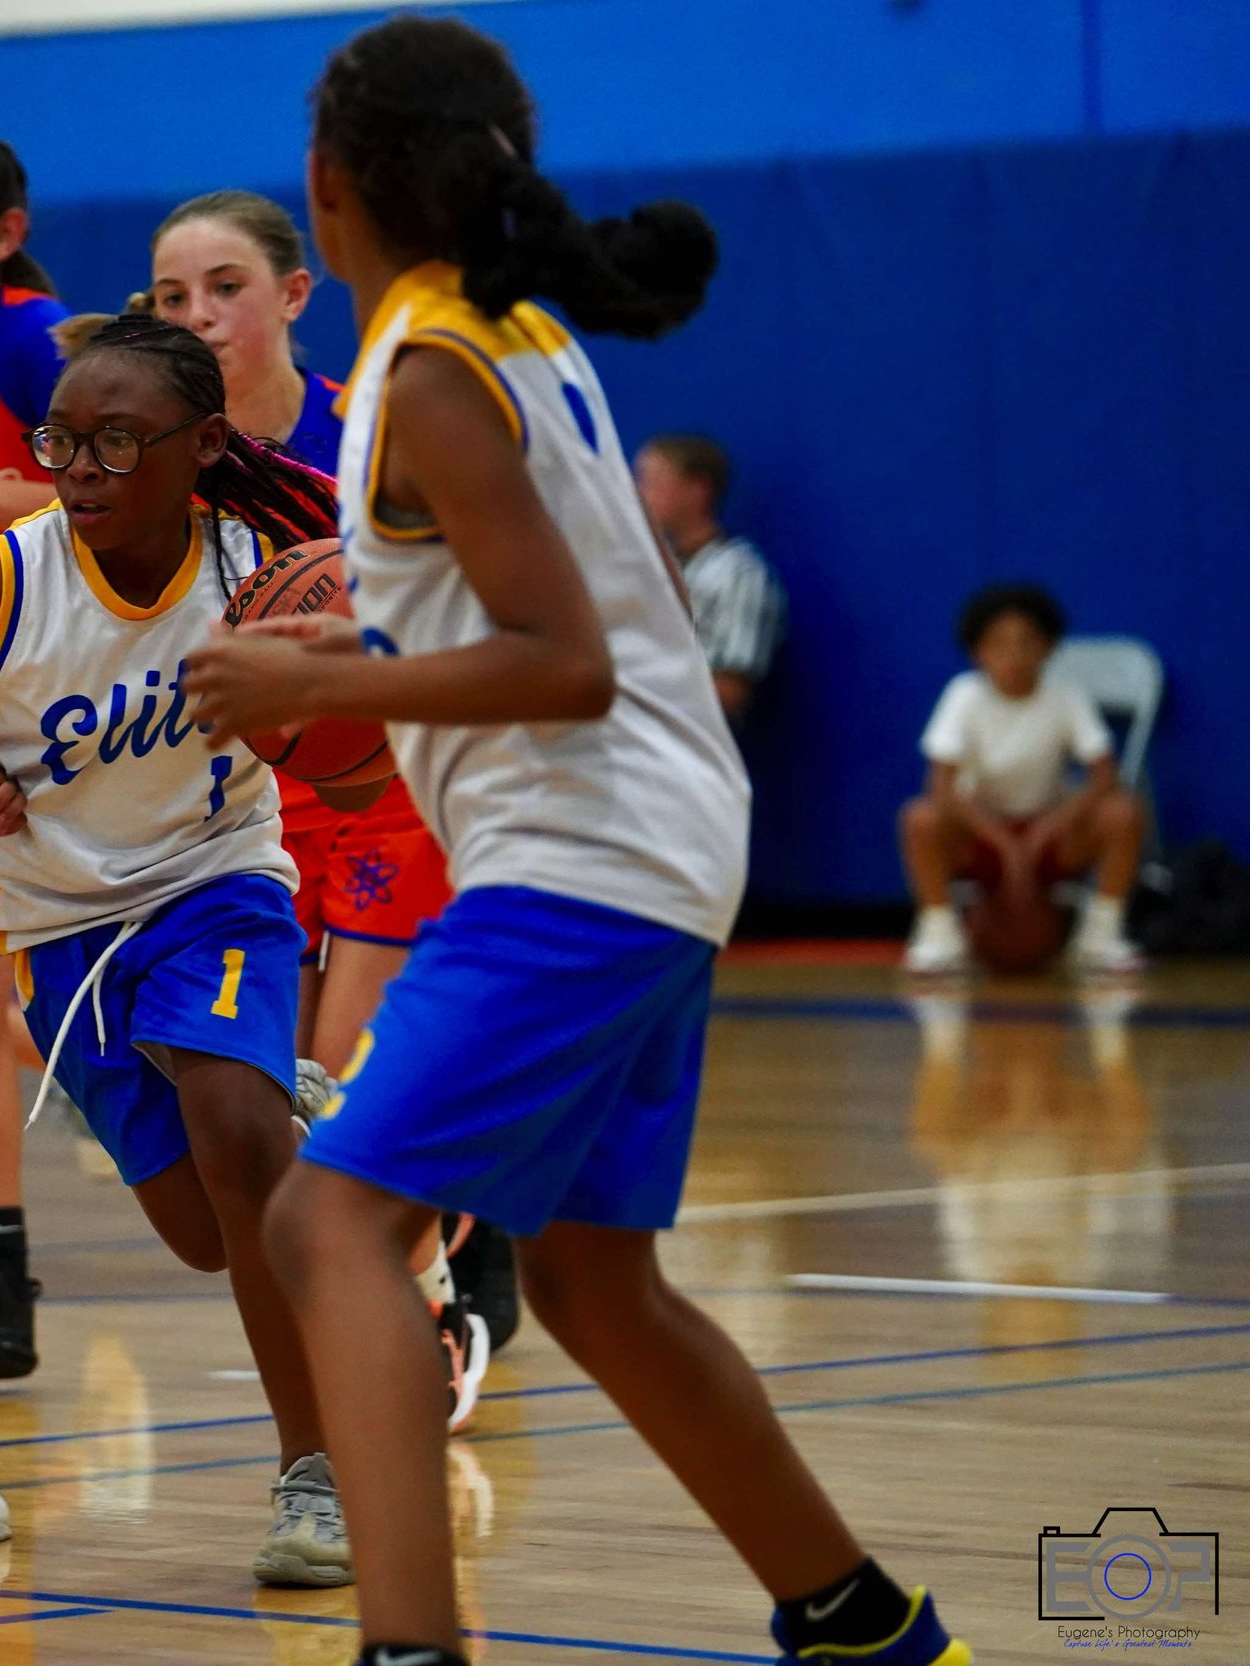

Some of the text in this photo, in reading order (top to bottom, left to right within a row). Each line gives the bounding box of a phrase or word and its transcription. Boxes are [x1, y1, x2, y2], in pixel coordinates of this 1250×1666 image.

[40, 658, 214, 785] Elit
[204, 755, 233, 822] 1
[210, 948, 245, 1019] 1
